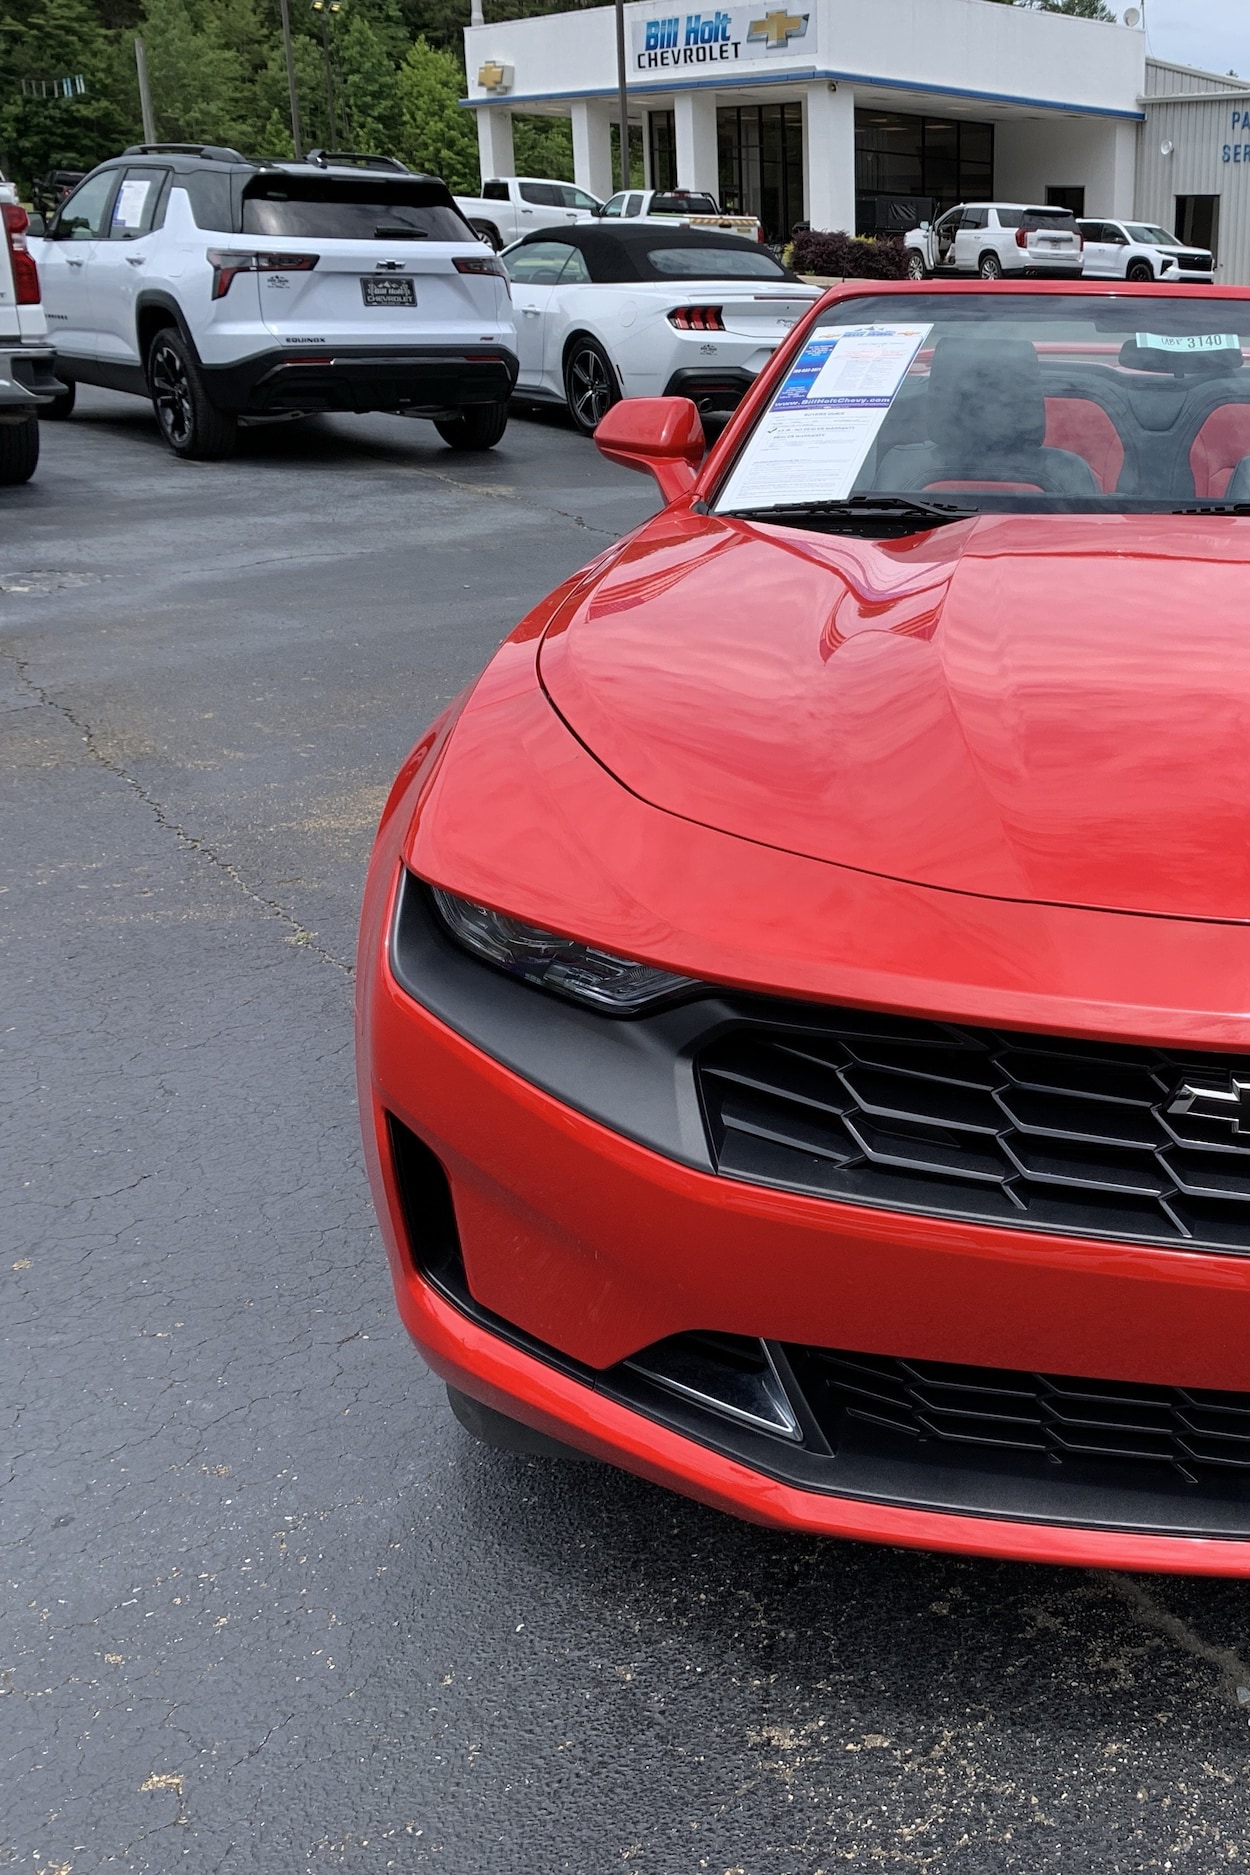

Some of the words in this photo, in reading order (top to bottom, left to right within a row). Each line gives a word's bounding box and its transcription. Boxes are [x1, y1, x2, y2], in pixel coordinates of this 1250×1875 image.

[645, 17, 679, 51] Bill
[685, 11, 732, 46] Holt
[637, 42, 741, 69] CHEVROLET
[1187, 335, 1222, 348] 3140
